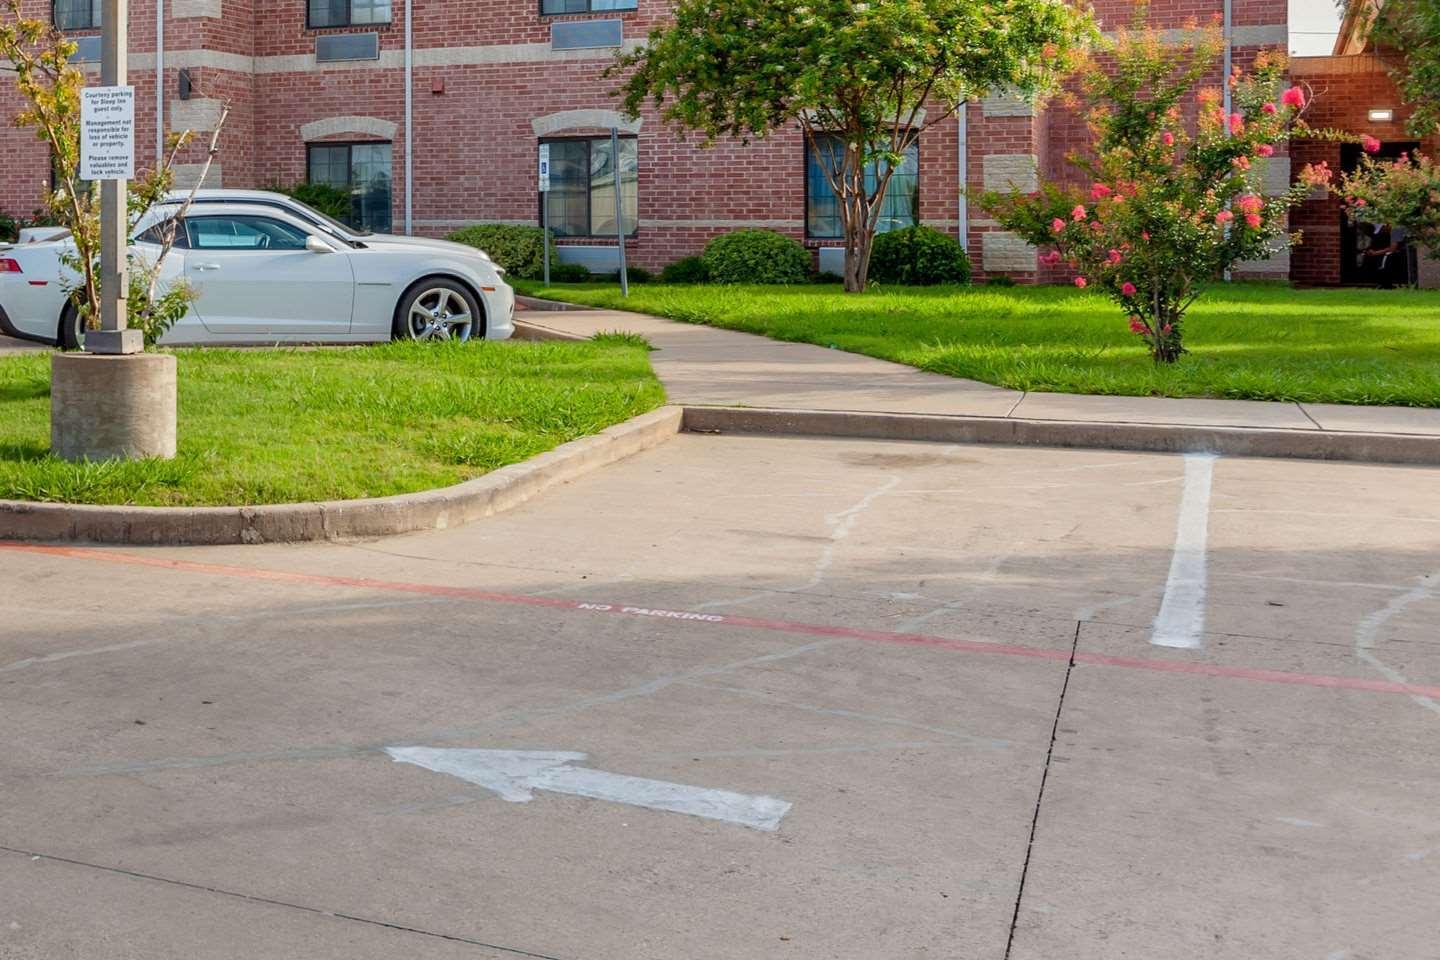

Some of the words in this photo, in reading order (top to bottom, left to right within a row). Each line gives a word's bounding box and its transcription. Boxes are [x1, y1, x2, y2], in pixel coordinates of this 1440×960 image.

[100, 98, 116, 106] Sleep
[578, 603, 611, 611] NO
[621, 607, 723, 621] PARKING
